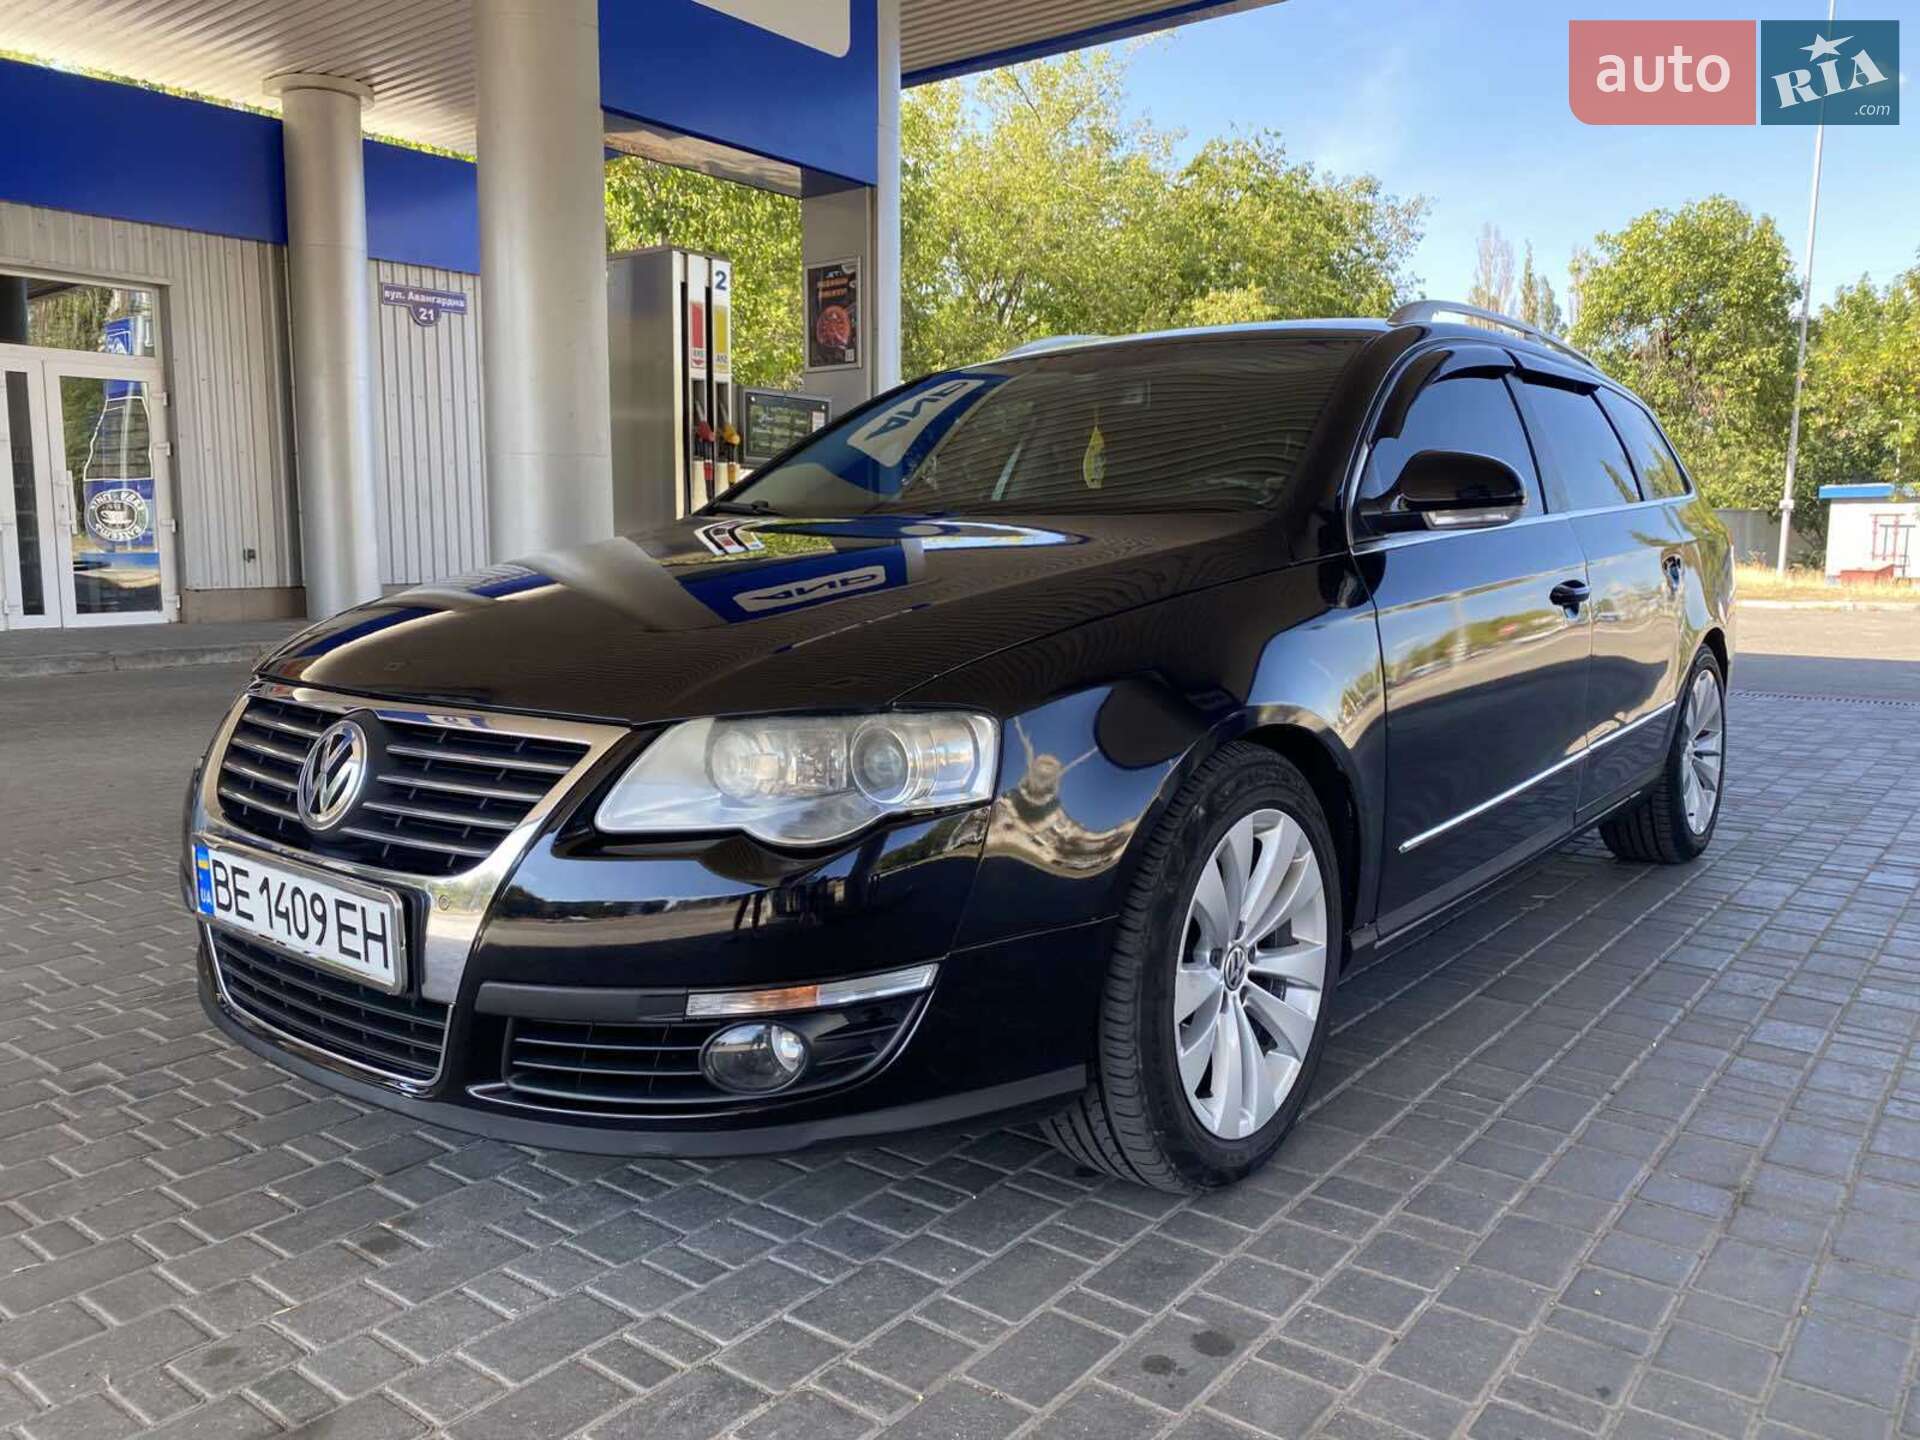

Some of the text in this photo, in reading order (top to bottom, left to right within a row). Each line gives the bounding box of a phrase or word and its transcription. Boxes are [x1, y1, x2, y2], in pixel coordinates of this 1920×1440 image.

[715, 270, 728, 291] 2
[419, 307, 434, 321] 21
[211, 859, 389, 970] BE 1409 EH
